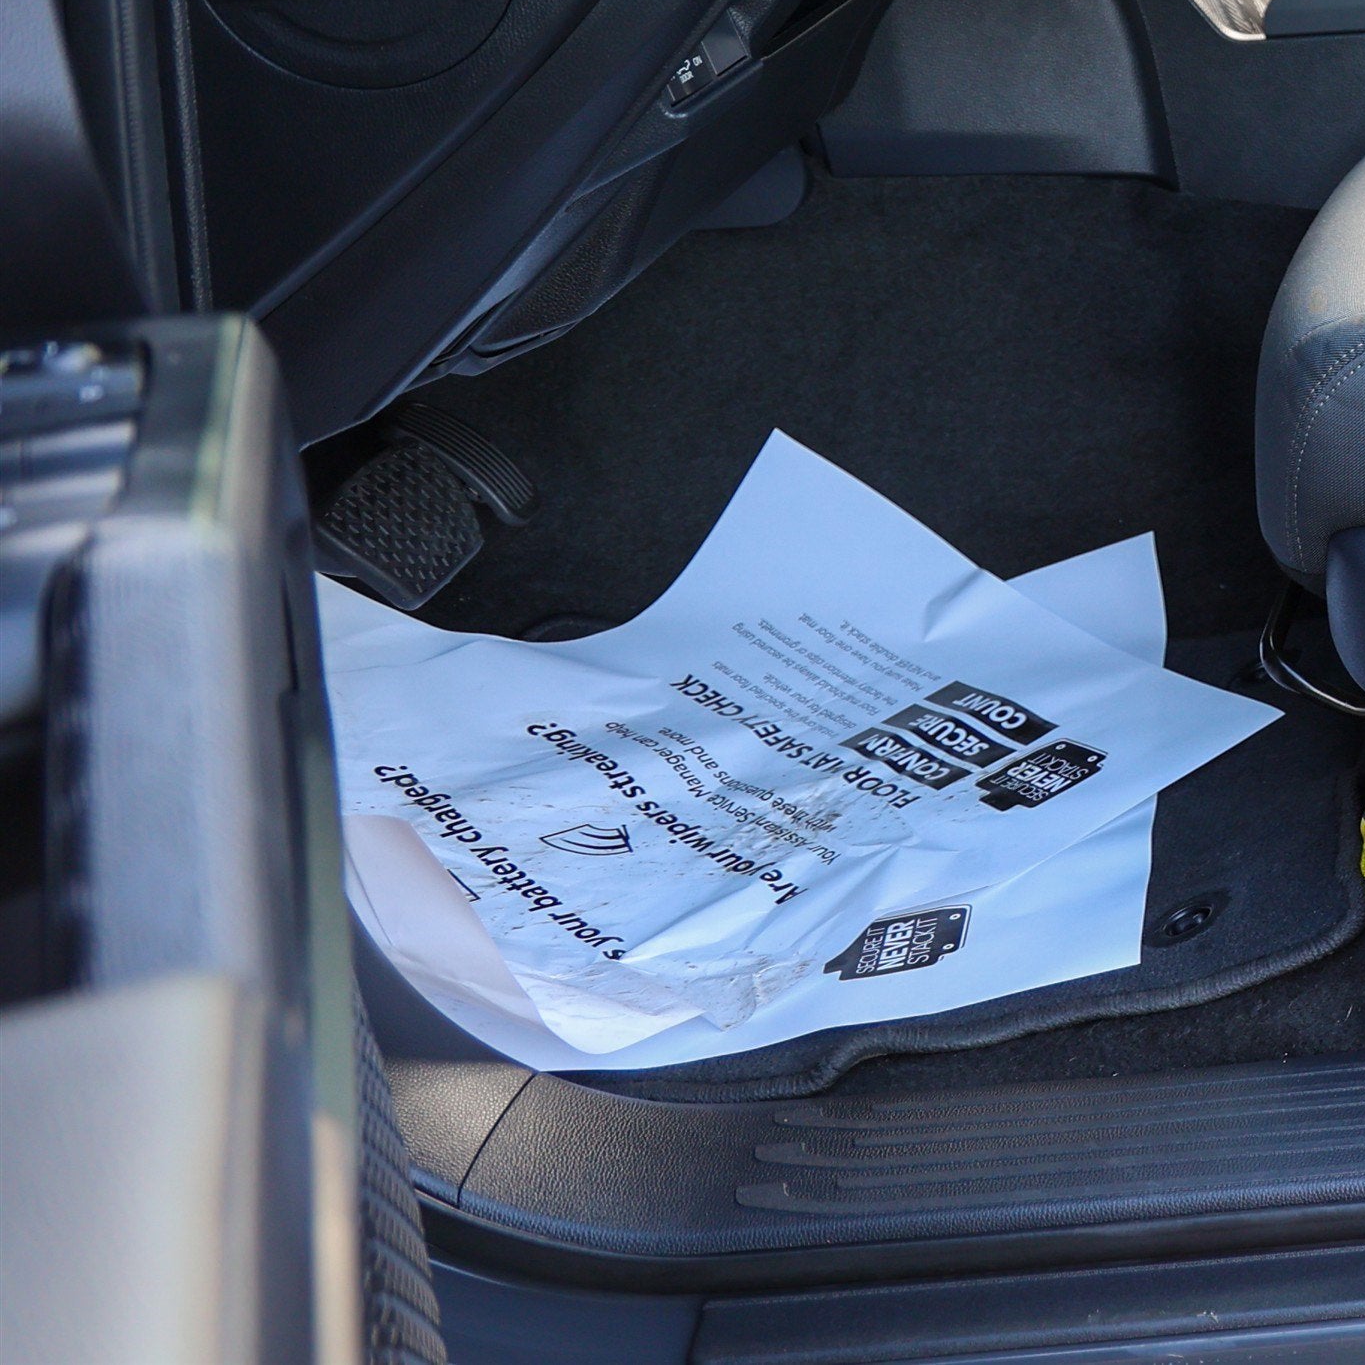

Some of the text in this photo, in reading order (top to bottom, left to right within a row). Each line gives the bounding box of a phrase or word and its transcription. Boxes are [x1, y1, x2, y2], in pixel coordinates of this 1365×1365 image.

[670, 672, 744, 720] CHECK
[951, 690, 1027, 731] COUNT
[737, 713, 813, 759] SAFETY
[856, 730, 950, 783] CONFIRM
[907, 712, 990, 758] SECURE
[683, 745, 719, 770] and
[1005, 759, 1072, 794] NEVER
[1027, 751, 1089, 781] STACK IT
[607, 721, 840, 864] Your Assistant Service Manager can help
[713, 769, 777, 800] questions
[842, 764, 920, 811] FLOOR
[988, 773, 1050, 803] SECURE IT
[525, 721, 808, 904] Are your wipers streaking?
[801, 814, 836, 833] with
[372, 763, 625, 962] s your battery charged?
[856, 937, 881, 973] SECURE
[876, 919, 914, 970] NEVER
[906, 927, 936, 962] STACK
